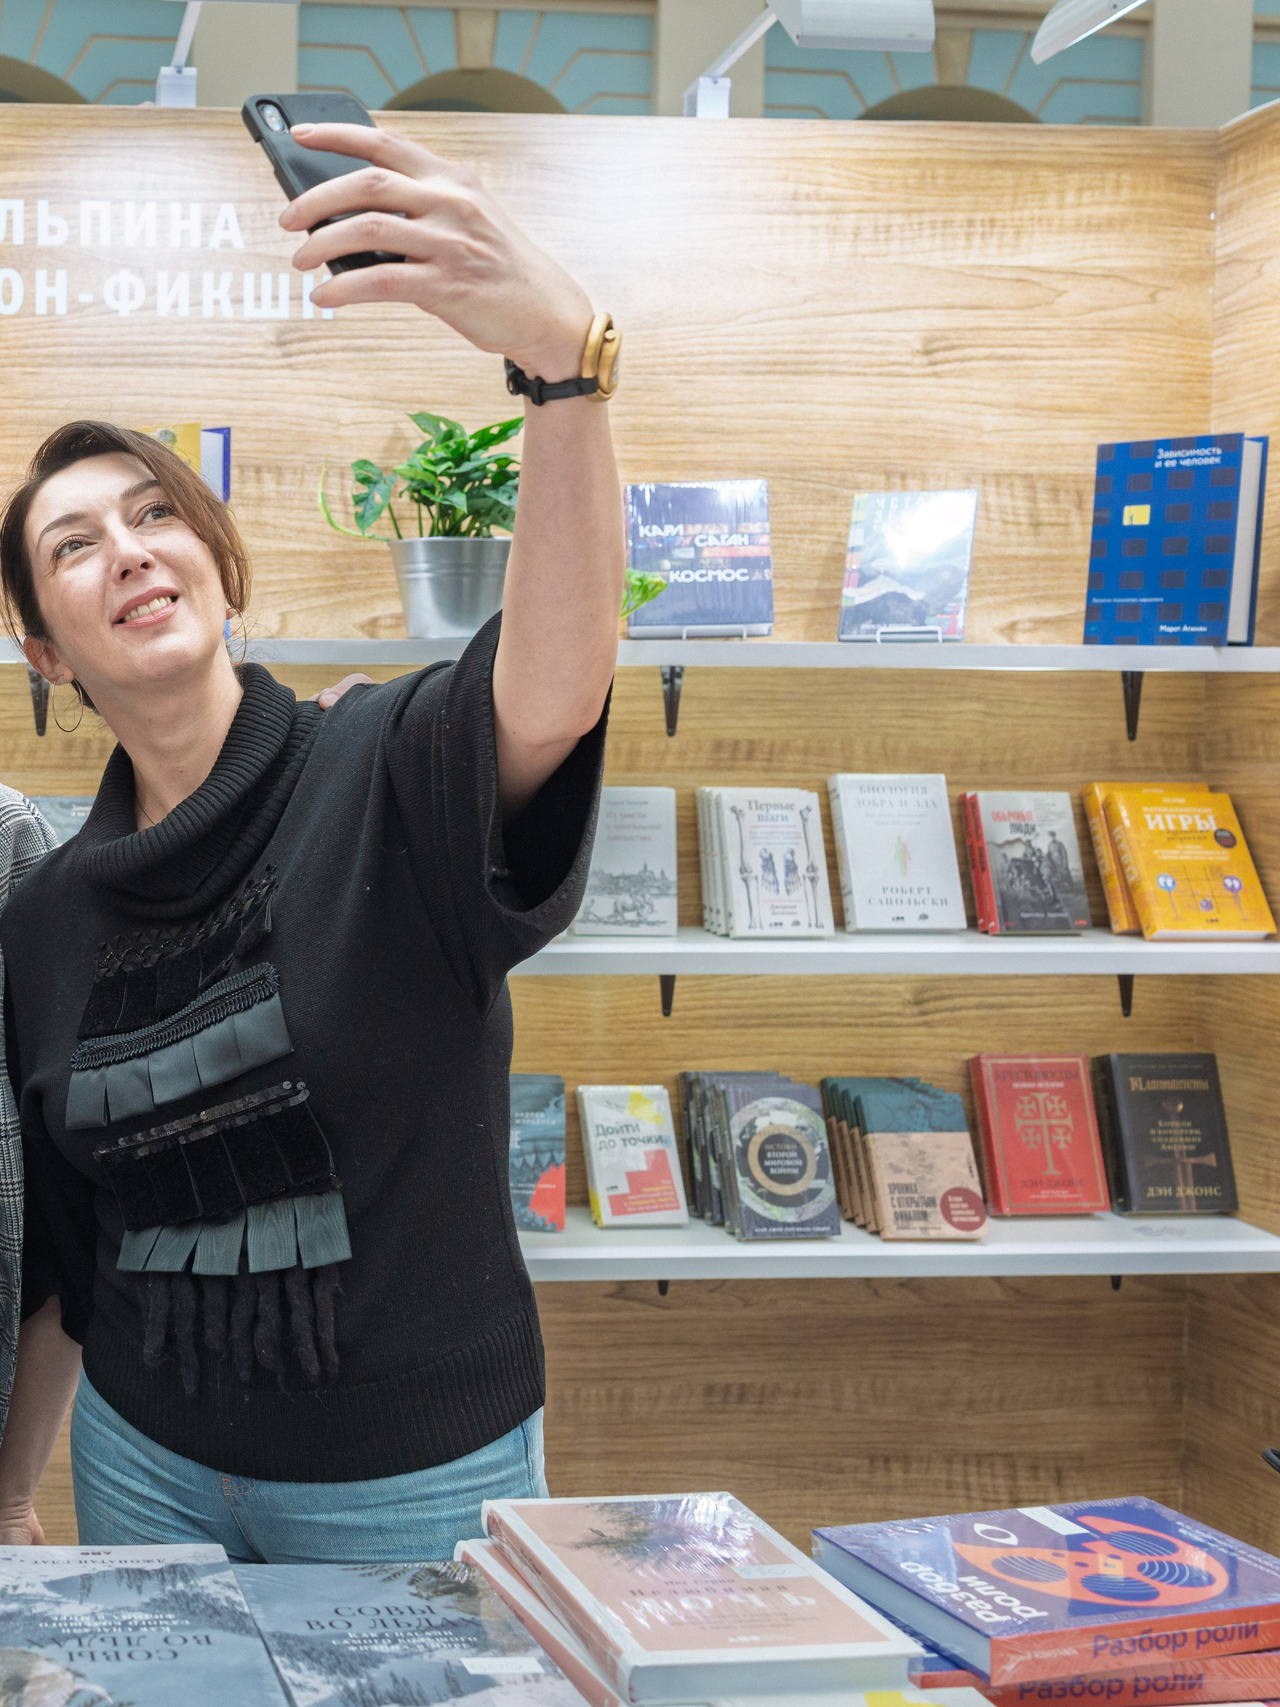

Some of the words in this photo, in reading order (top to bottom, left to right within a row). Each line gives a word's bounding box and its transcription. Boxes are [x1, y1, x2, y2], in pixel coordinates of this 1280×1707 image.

[1156, 447, 1222, 460] Зависимость
[1179, 456, 1222, 467] человек
[638, 523, 685, 538] КАРЛ
[694, 534, 749, 547] САГАН
[669, 568, 750, 583] КОСМОС
[747, 799, 796, 813] Первые
[1144, 813, 1219, 831] ИГРЫ
[595, 1122, 640, 1138] Дойти
[598, 1139, 618, 1152] до
[1147, 1186, 1173, 1199] ДЭН
[1176, 1186, 1222, 1198] ДЖОНС
[899, 1560, 1014, 1624] Разбор
[956, 1575, 1050, 1619] роли
[333, 1605, 437, 1618] СОВЫ
[304, 1620, 353, 1631] ВО
[370, 1616, 484, 1630] ЛЬДАХ
[25, 1634, 147, 1648] ЛЬДАХ
[162, 1635, 213, 1646] ВО
[1091, 1628, 1190, 1659] Разбор
[1194, 1620, 1261, 1650] роли
[67, 1649, 179, 1662] СОВЫ
[1020, 1673, 1126, 1701] Разбор
[1132, 1672, 1206, 1699] роли
